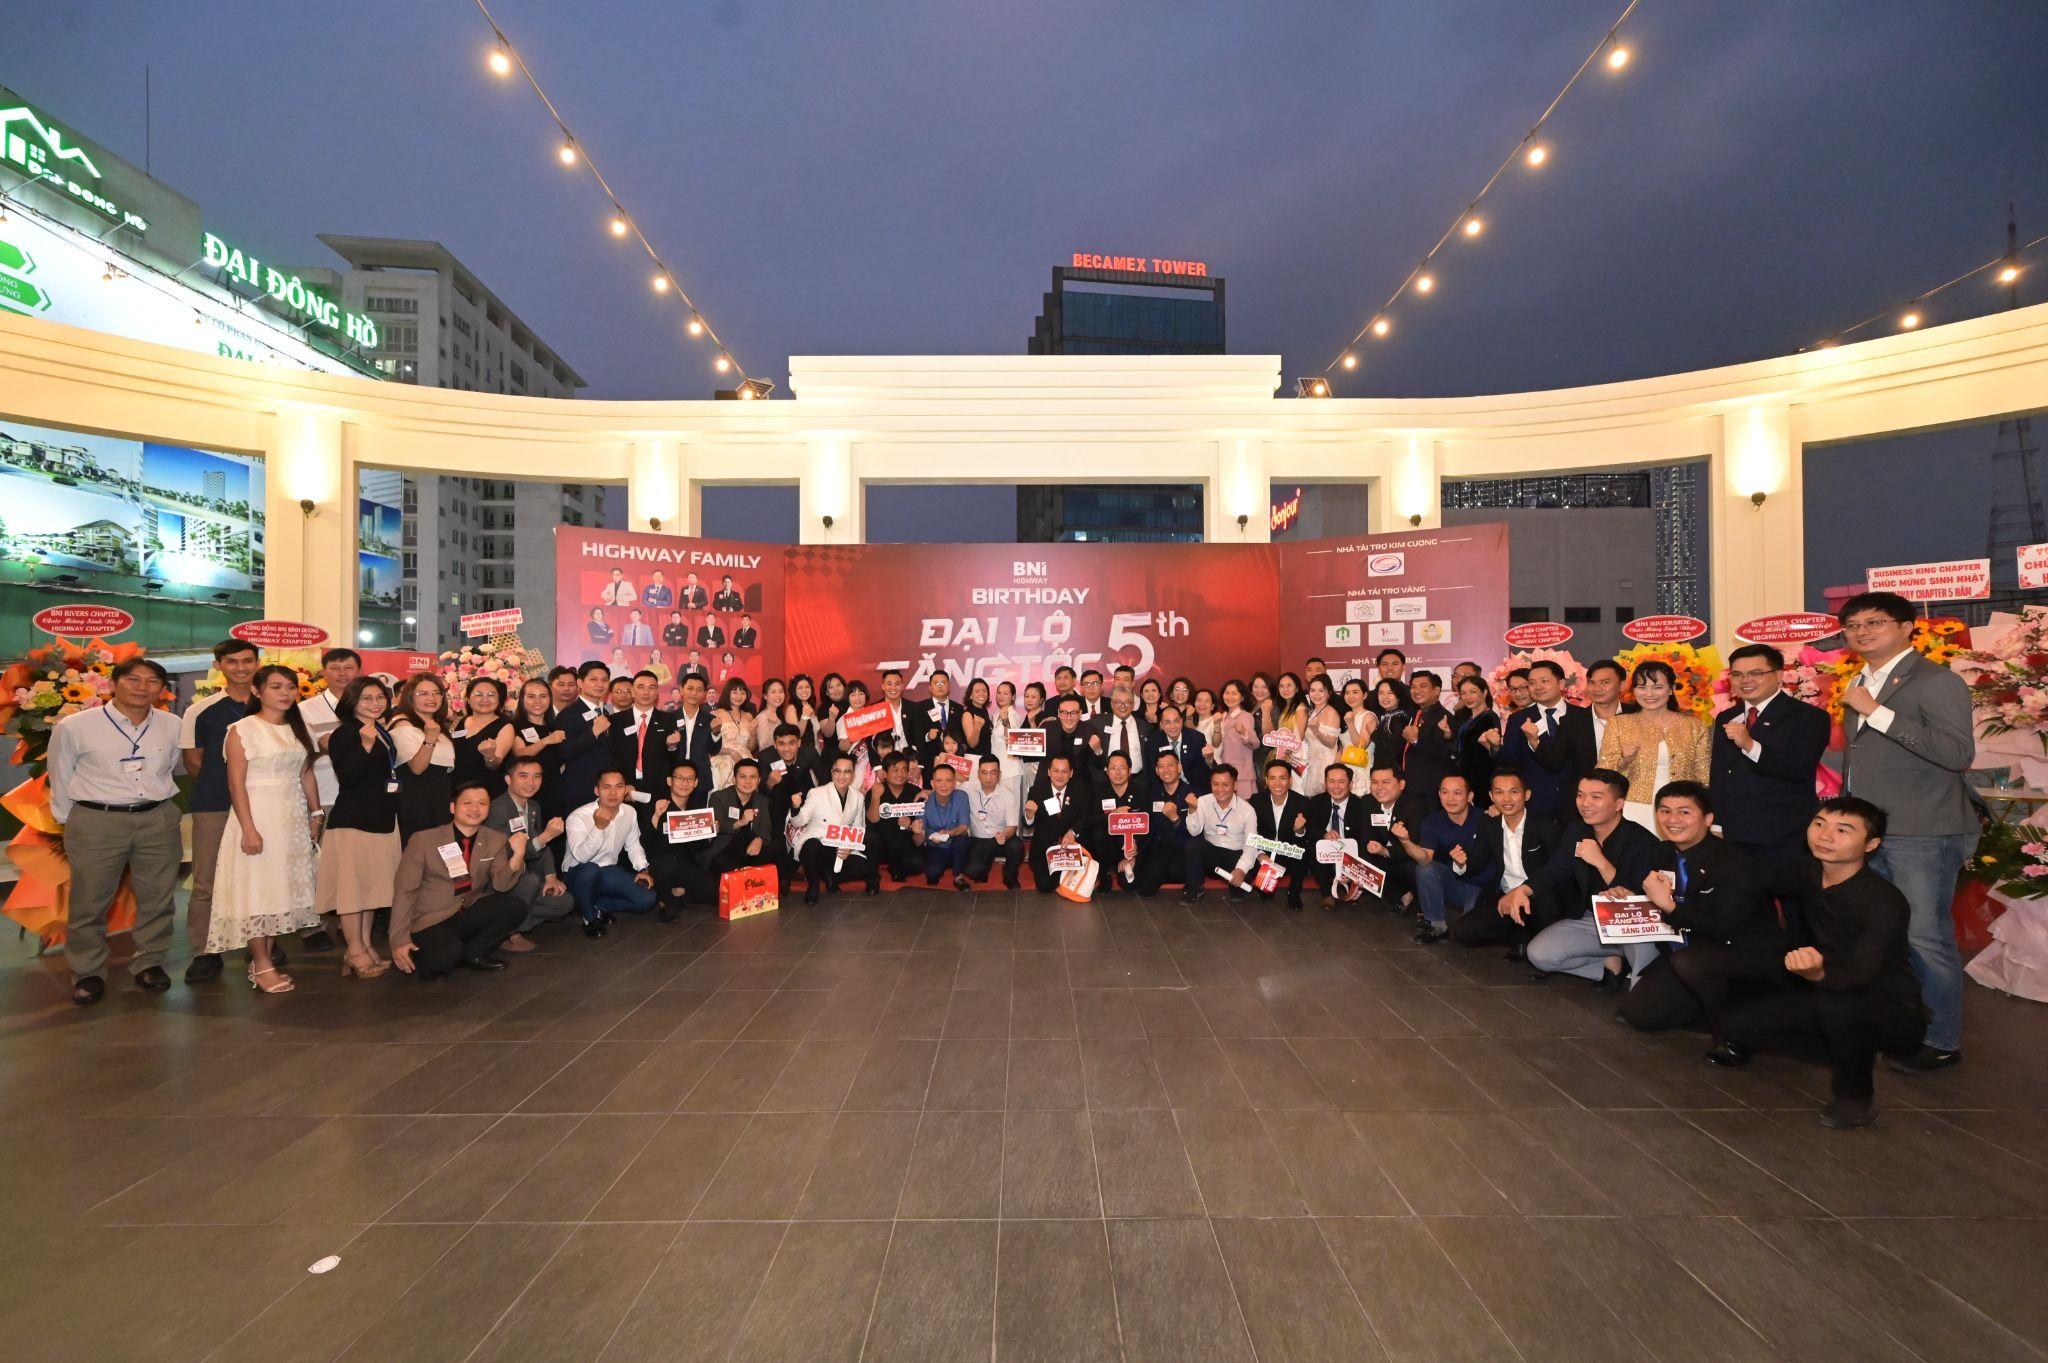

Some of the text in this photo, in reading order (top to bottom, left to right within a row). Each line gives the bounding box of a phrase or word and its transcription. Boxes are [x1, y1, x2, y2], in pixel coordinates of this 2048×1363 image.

[203, 232, 260, 287] ĐẠI
[1072, 253, 1208, 277] BECAMEX TOWER
[1389, 541, 1406, 549] KIM
[581, 542, 762, 569] HIGHWAY FAMILY
[1874, 563, 1981, 578] BUSINESS KING CHAPTER
[1012, 577, 1049, 585] HIGHWAY
[1872, 579, 1898, 589] CHÚC
[1929, 577, 1954, 585] SINH
[1956, 573, 1985, 584] NHẬT
[972, 587, 1091, 605] BIRTHDAY
[1915, 589, 1947, 600] CHAPTER
[1948, 589, 1954, 598] 5
[1955, 585, 1973, 597] NĂM
[491, 608, 521, 618] CHAPTER
[1765, 619, 1789, 627] JEWEL
[1790, 616, 1827, 624] CHAPTER
[919, 609, 1073, 652] ĐẠI LỘ
[1752, 633, 1788, 641] HIGHWAY
[1265, 736, 1300, 750] Birthday
[1256, 838, 1282, 850] Smart
[1282, 843, 1305, 854] Solar
[1621, 923, 1660, 934] SÁNG SUỐT
